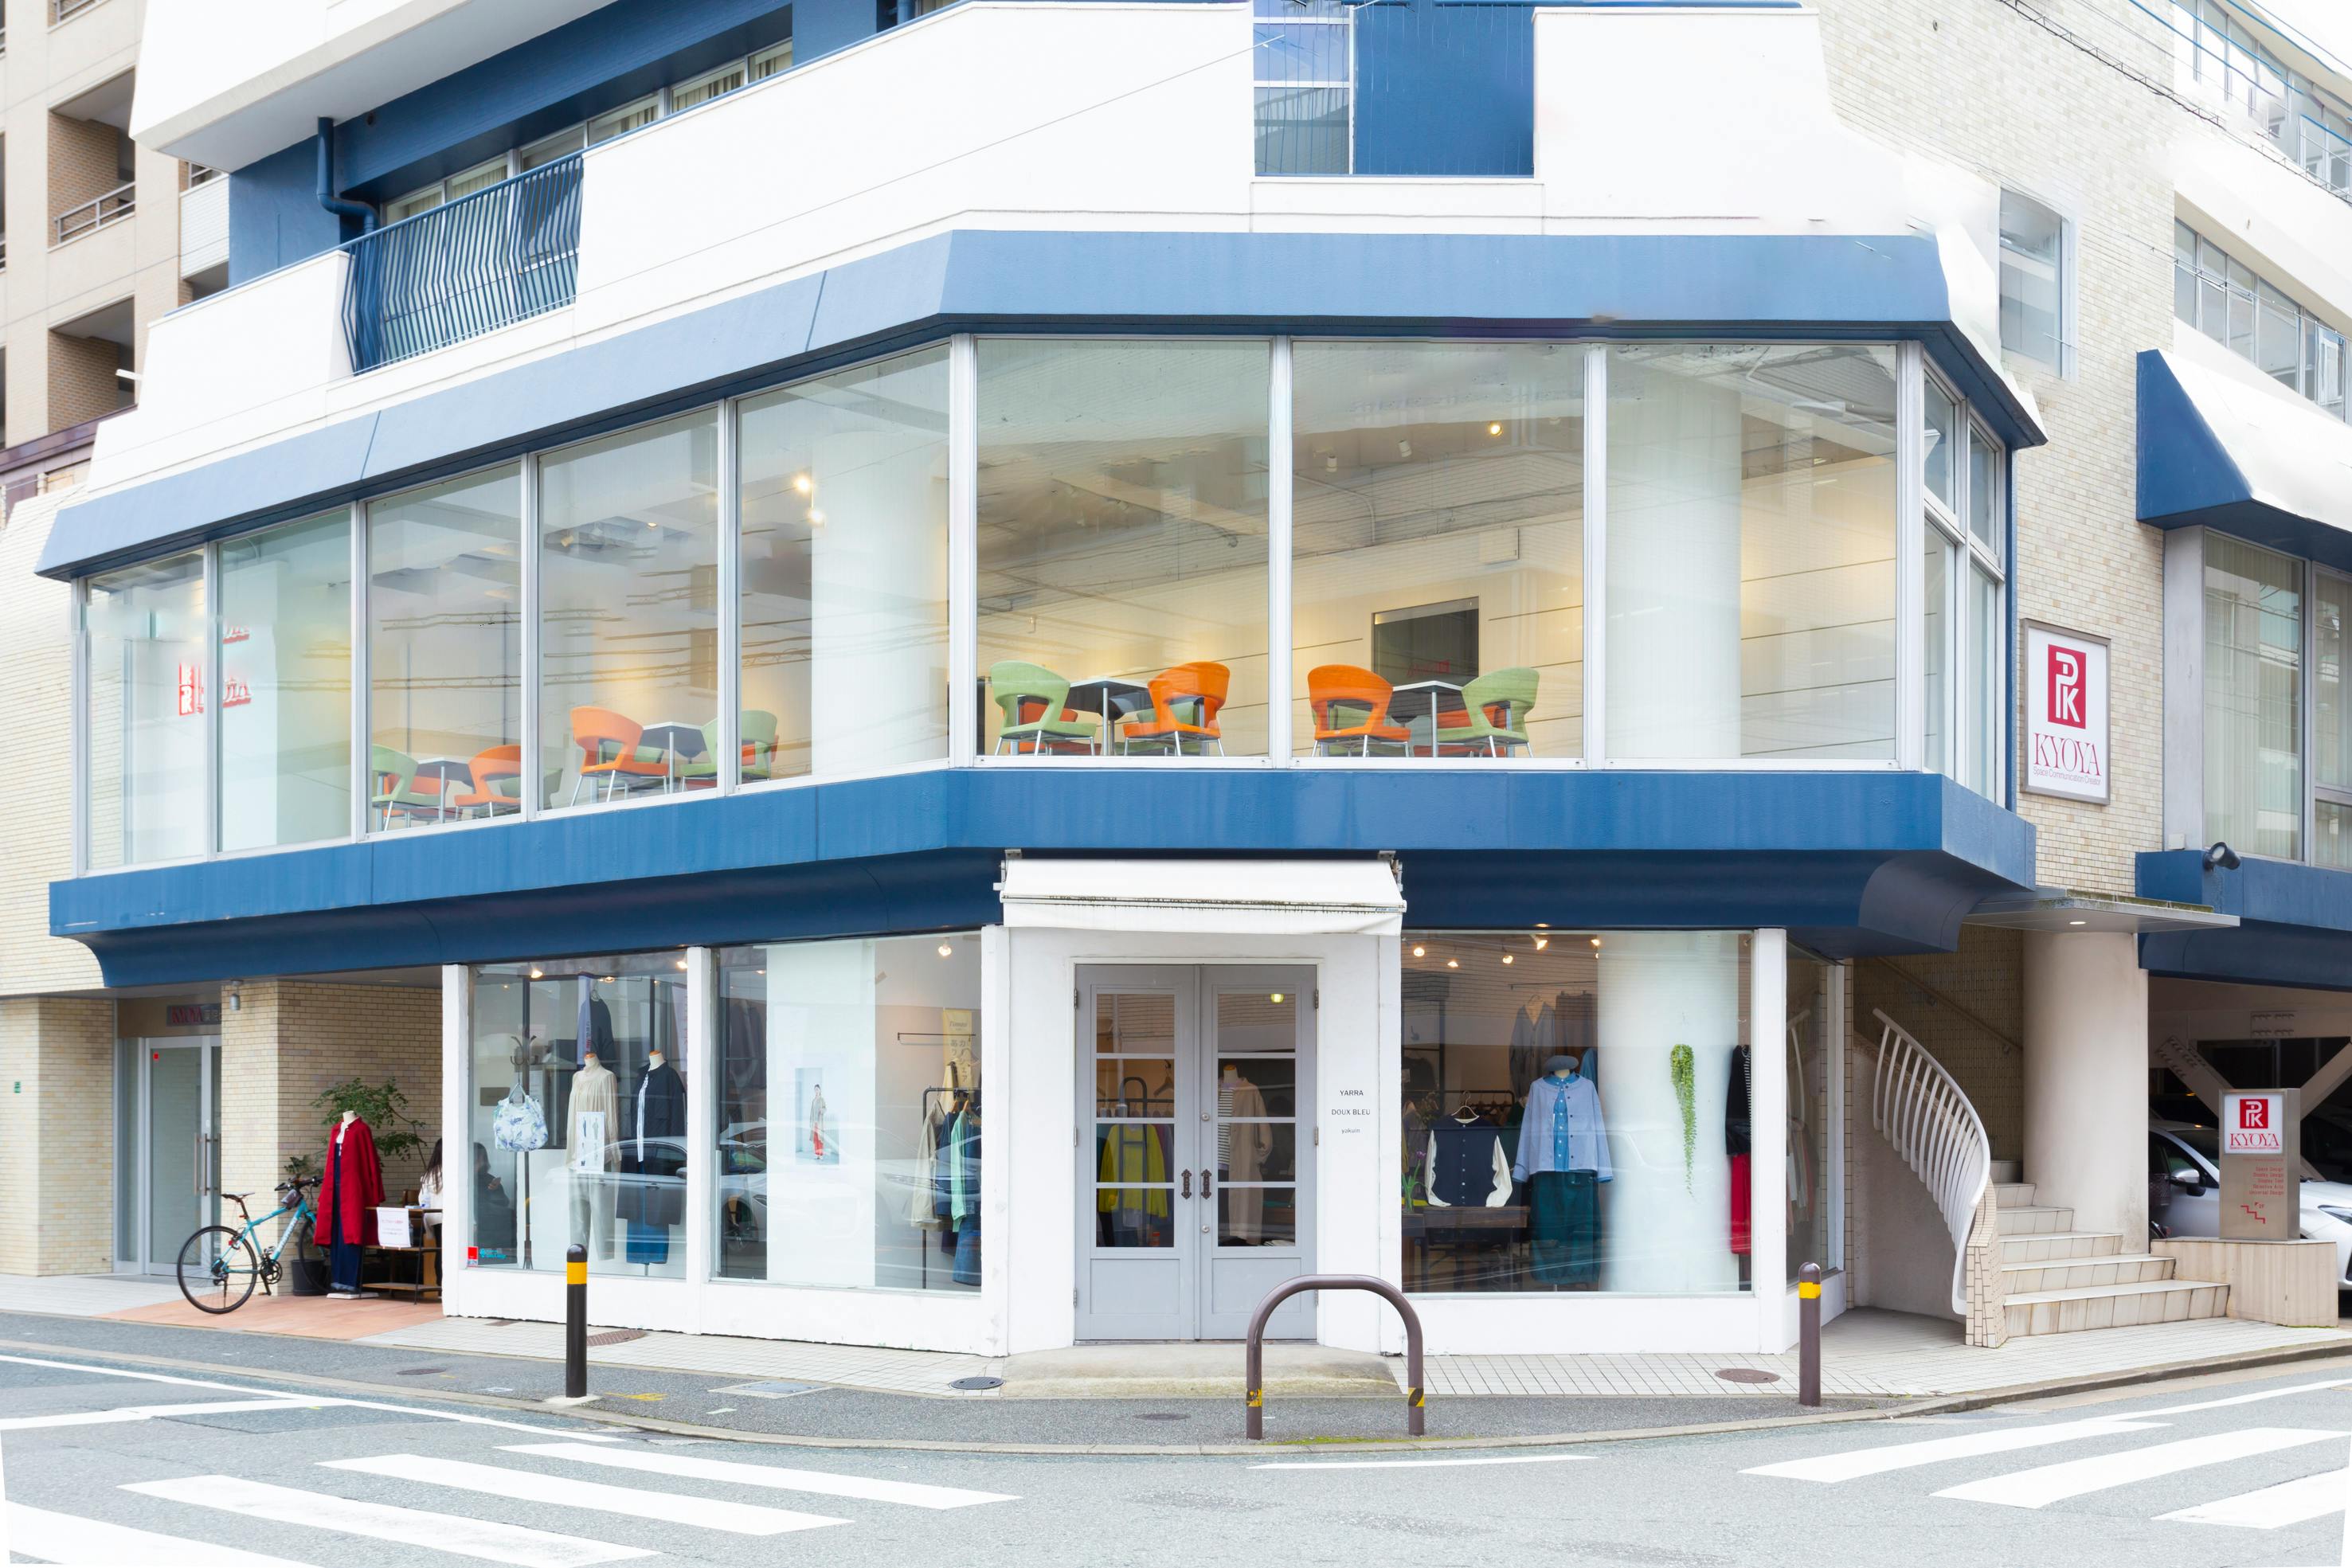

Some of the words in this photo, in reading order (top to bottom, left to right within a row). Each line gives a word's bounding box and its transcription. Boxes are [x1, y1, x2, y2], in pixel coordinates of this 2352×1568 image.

[2033, 733, 2101, 776] KYOYA
[2033, 766, 2049, 777] Space
[2049, 768, 2084, 784] Communication
[2084, 775, 2101, 785] Creator
[2229, 1133, 2280, 1146] KYOYA
